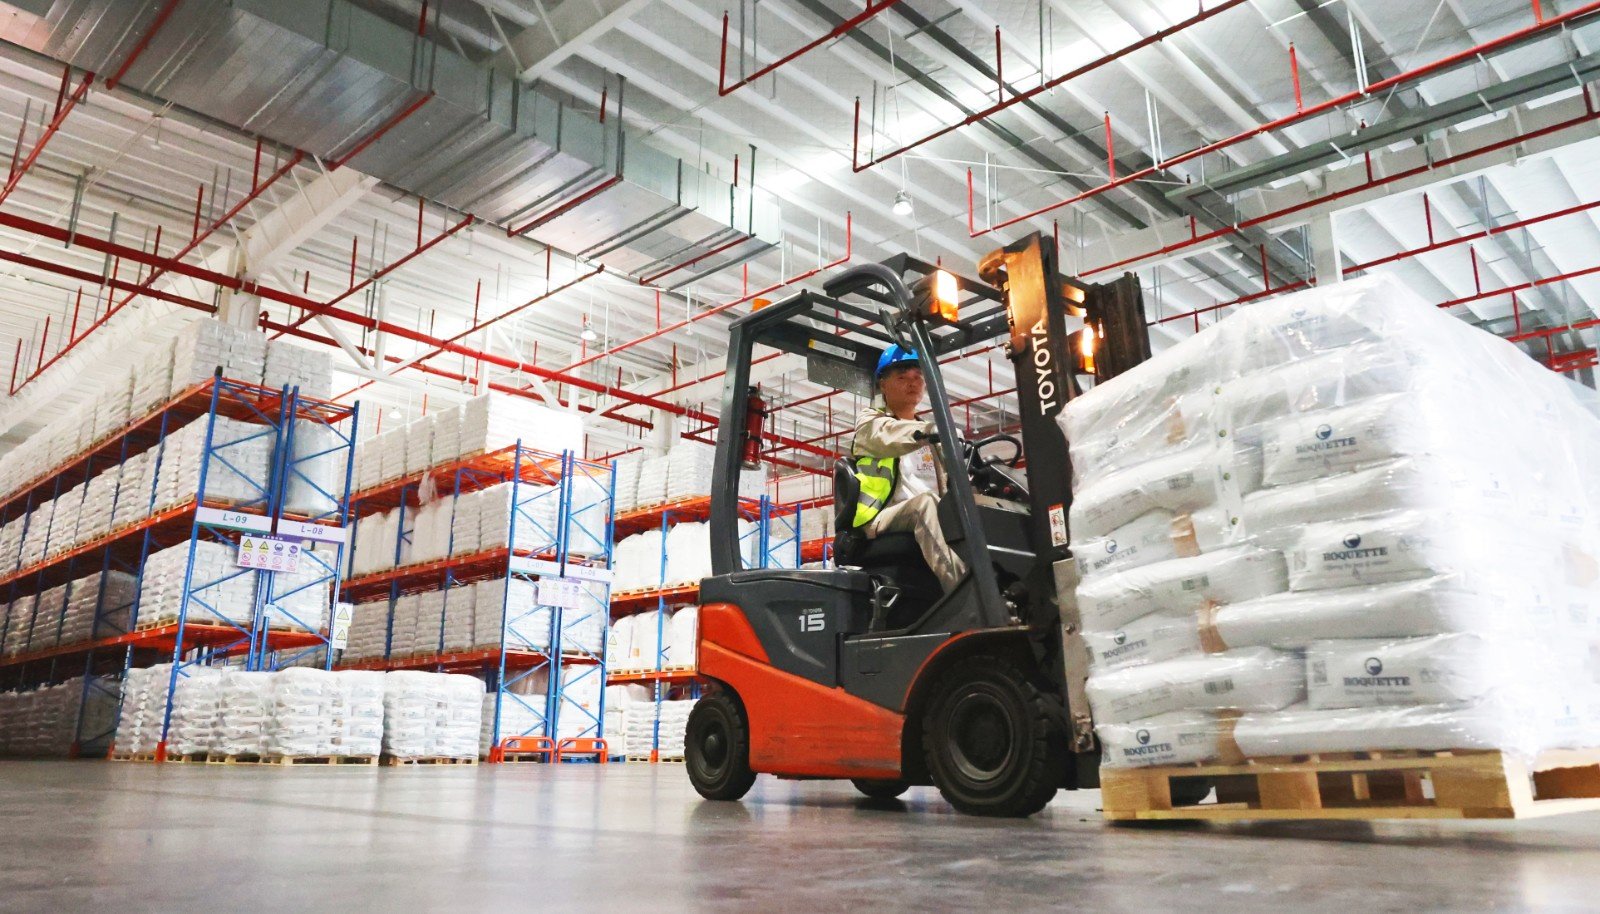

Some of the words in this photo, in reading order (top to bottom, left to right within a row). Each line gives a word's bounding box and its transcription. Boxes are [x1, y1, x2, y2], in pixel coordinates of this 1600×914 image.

[1031, 319, 1056, 416] TOYOTA
[1295, 436, 1358, 454] ROQUETTE
[222, 513, 248, 524] L-09
[301, 525, 324, 535] L-08
[1093, 545, 1138, 570] ROQUETTE
[1322, 546, 1388, 561] ROQUETTE
[799, 613, 825, 632] 15
[1102, 639, 1148, 659] ROQUETTE
[1343, 676, 1411, 687] ROQUETTE
[1123, 742, 1173, 756] ROQUETTE
